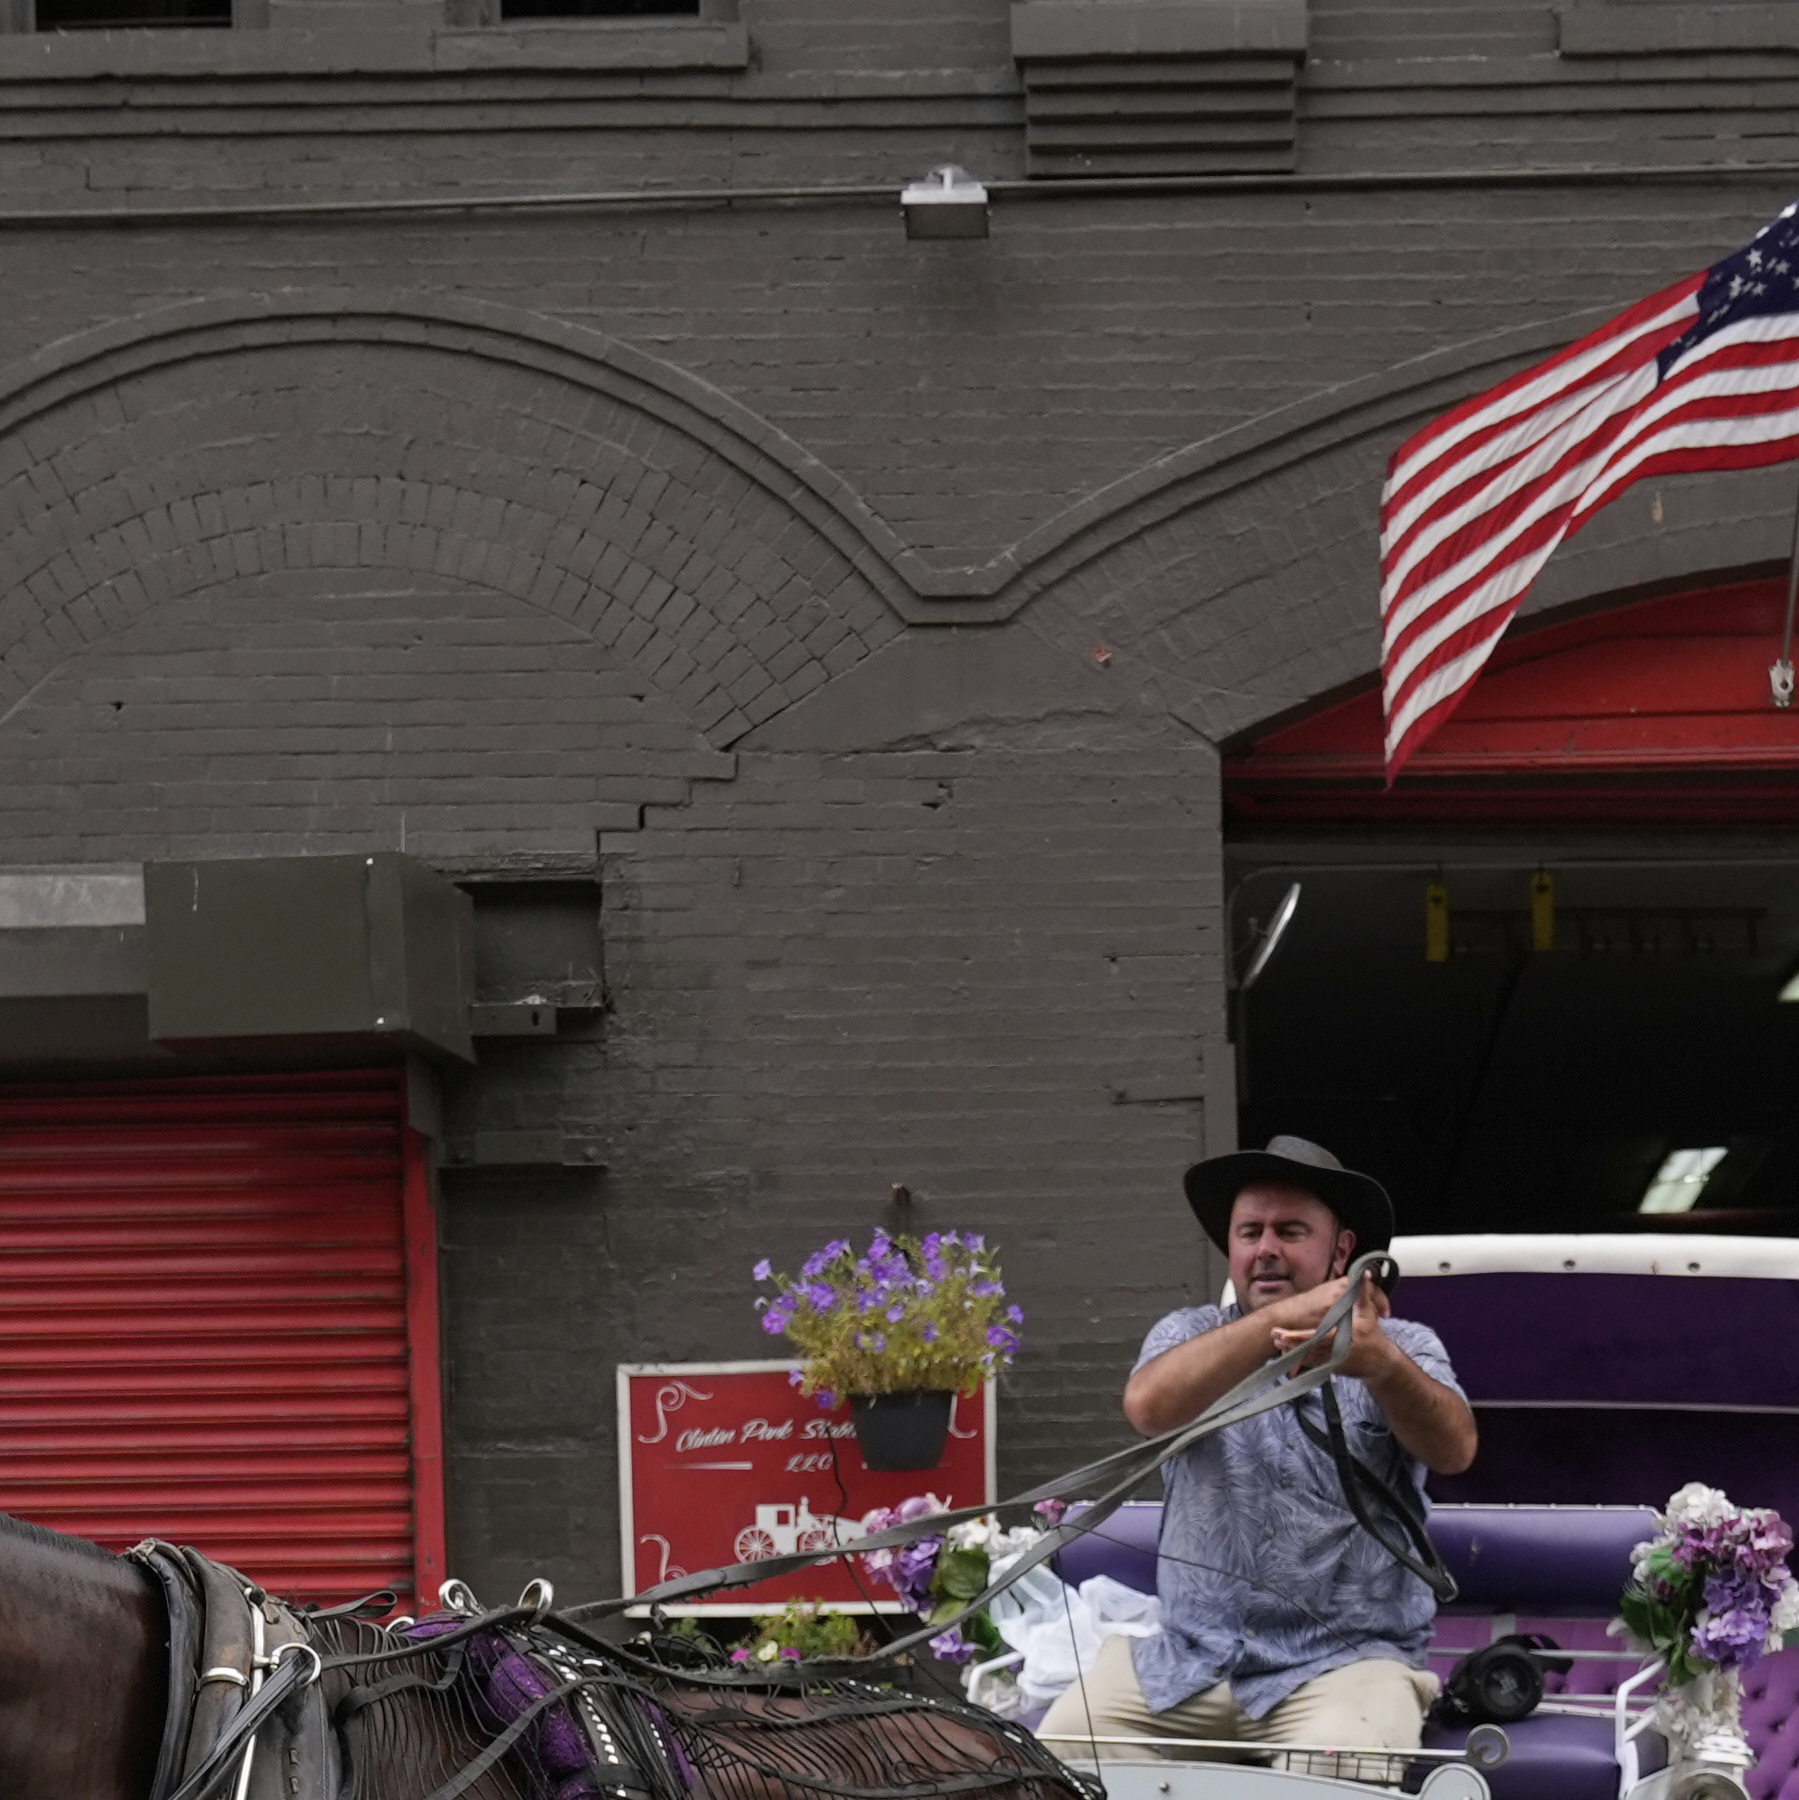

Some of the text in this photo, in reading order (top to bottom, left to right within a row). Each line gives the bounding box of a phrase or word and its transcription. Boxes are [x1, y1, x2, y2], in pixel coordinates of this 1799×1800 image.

[676, 1427, 736, 1453] Clinton
[740, 1417, 794, 1444] Park
[784, 1453, 834, 1472] LLC
